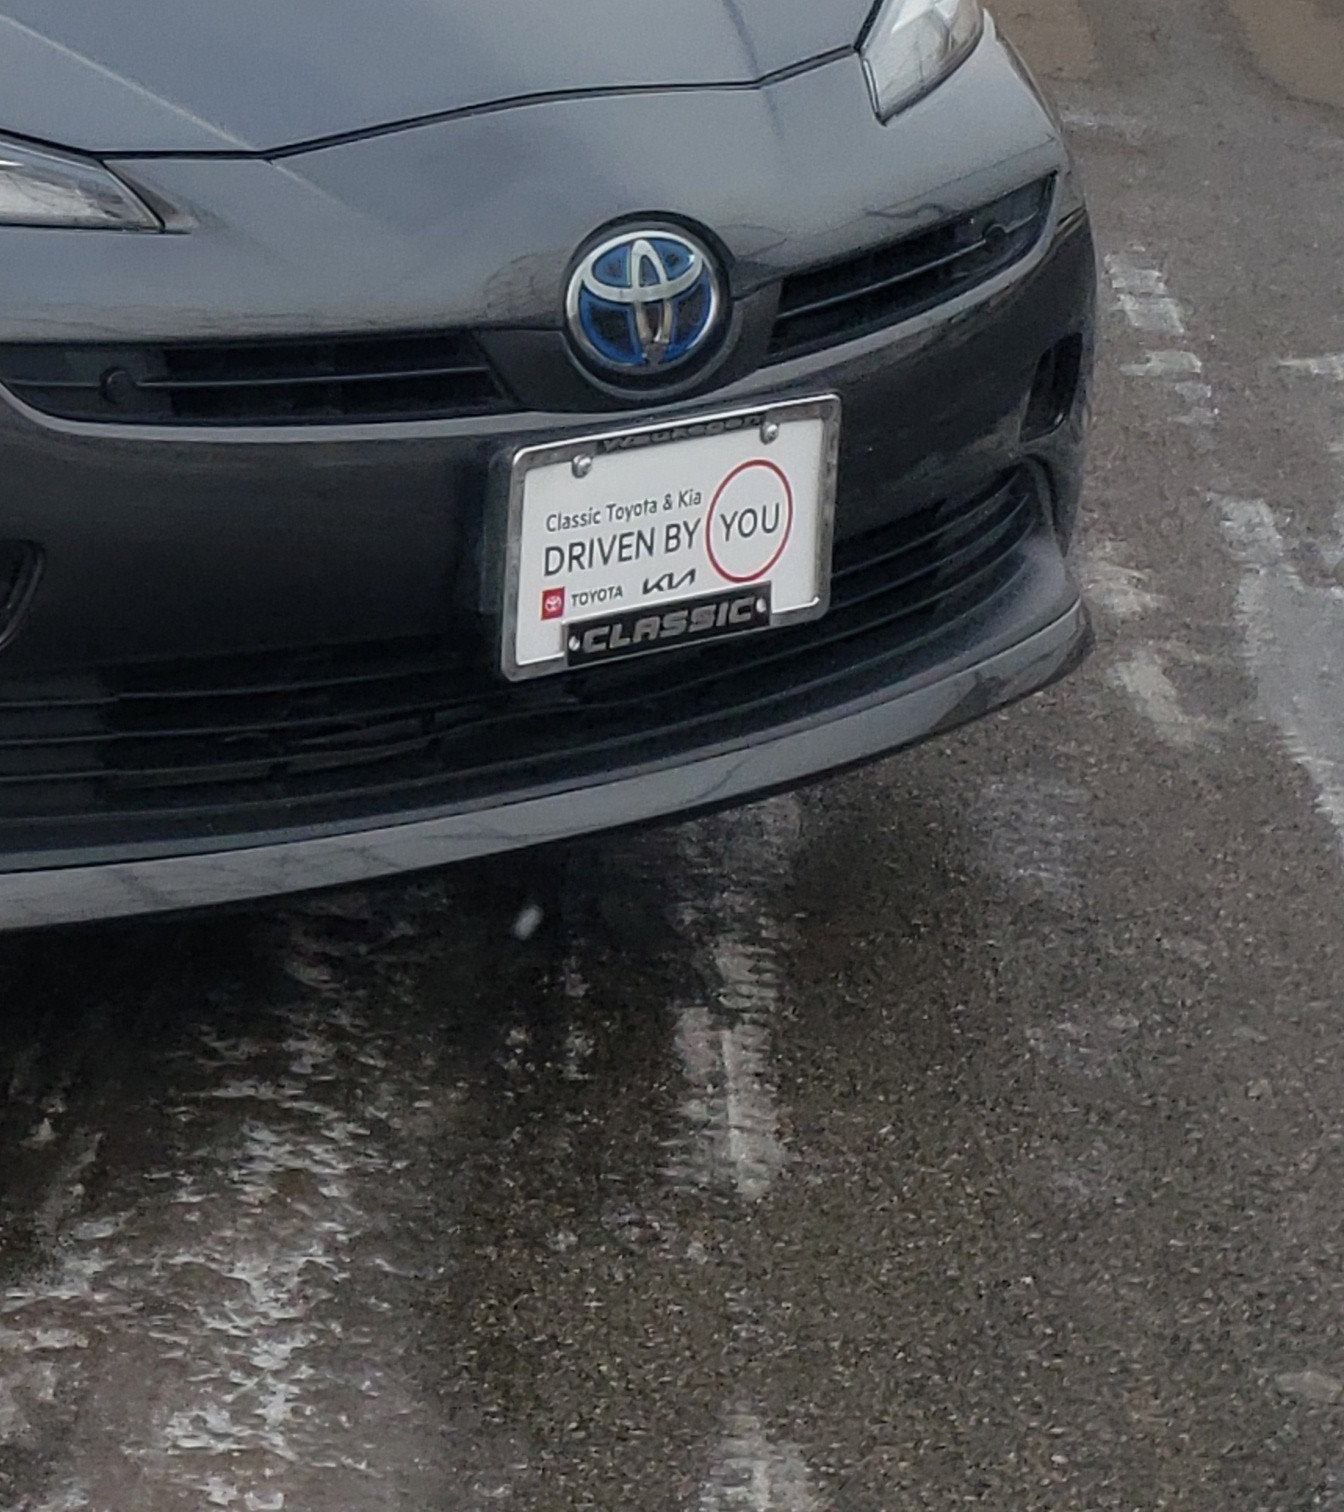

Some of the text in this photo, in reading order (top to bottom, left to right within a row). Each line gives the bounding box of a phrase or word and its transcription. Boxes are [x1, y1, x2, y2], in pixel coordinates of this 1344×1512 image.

[546, 489, 702, 532] Classic Toyota & Kia
[544, 502, 780, 576] DRIVEN BY YOU
[571, 586, 623, 607] TOYOTA
[582, 596, 755, 653] CLASSIC
